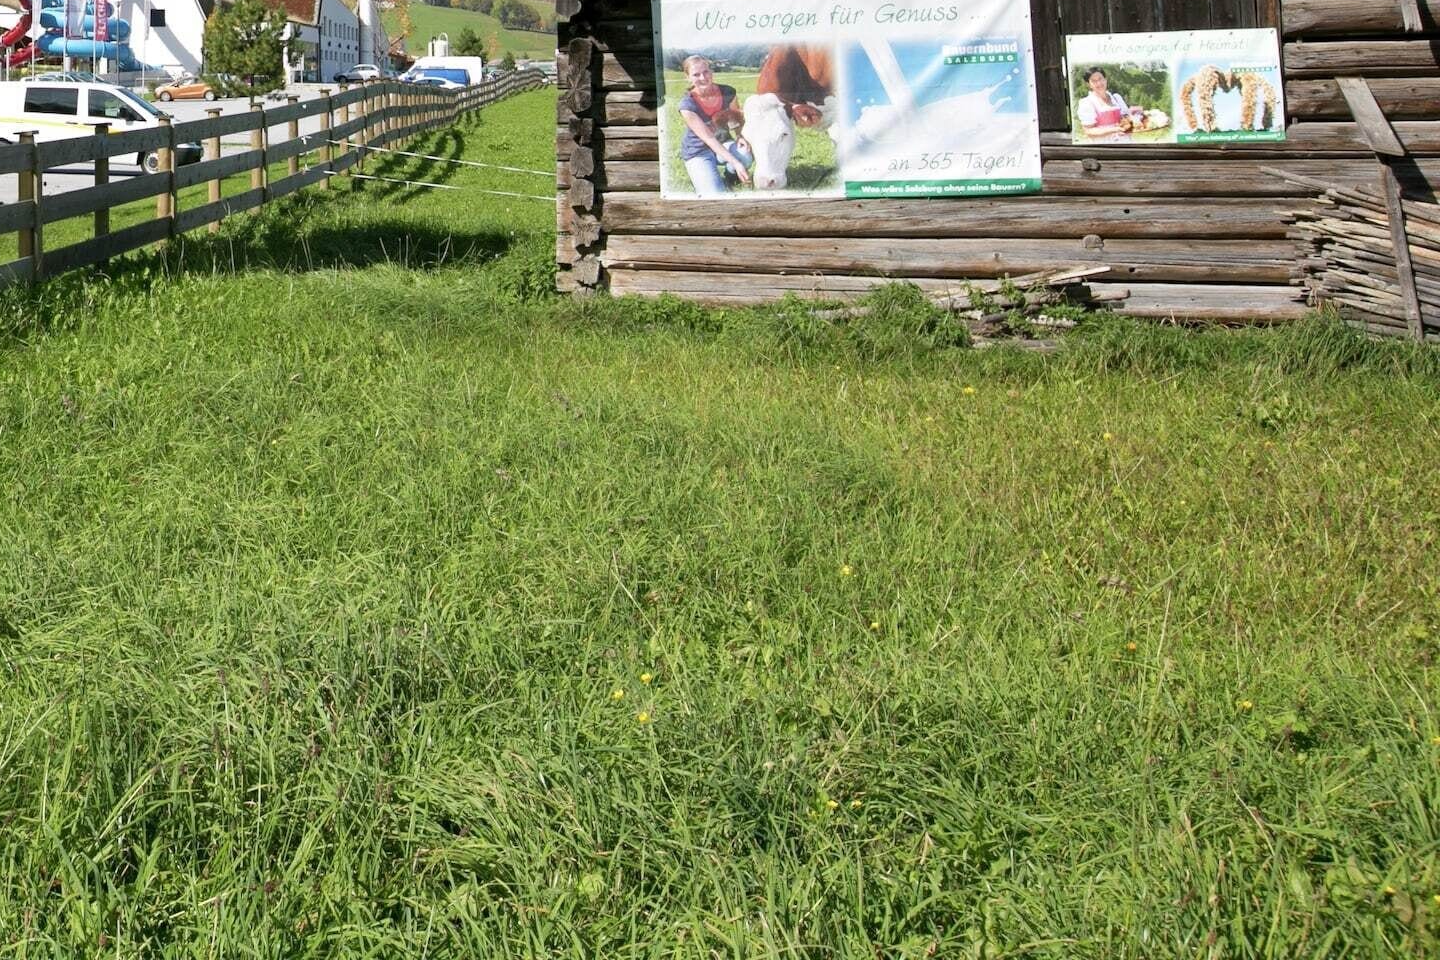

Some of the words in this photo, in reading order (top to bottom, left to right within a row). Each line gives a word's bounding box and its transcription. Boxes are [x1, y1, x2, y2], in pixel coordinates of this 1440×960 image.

[694, 9, 737, 32] Wir
[745, 11, 819, 35] sorgen
[830, 4, 865, 26] für
[874, 2, 959, 24] Genuss
[946, 54, 1015, 64] SALZBURG
[888, 157, 911, 172] an
[917, 151, 954, 171] 365
[962, 150, 1025, 176] Tagen!
